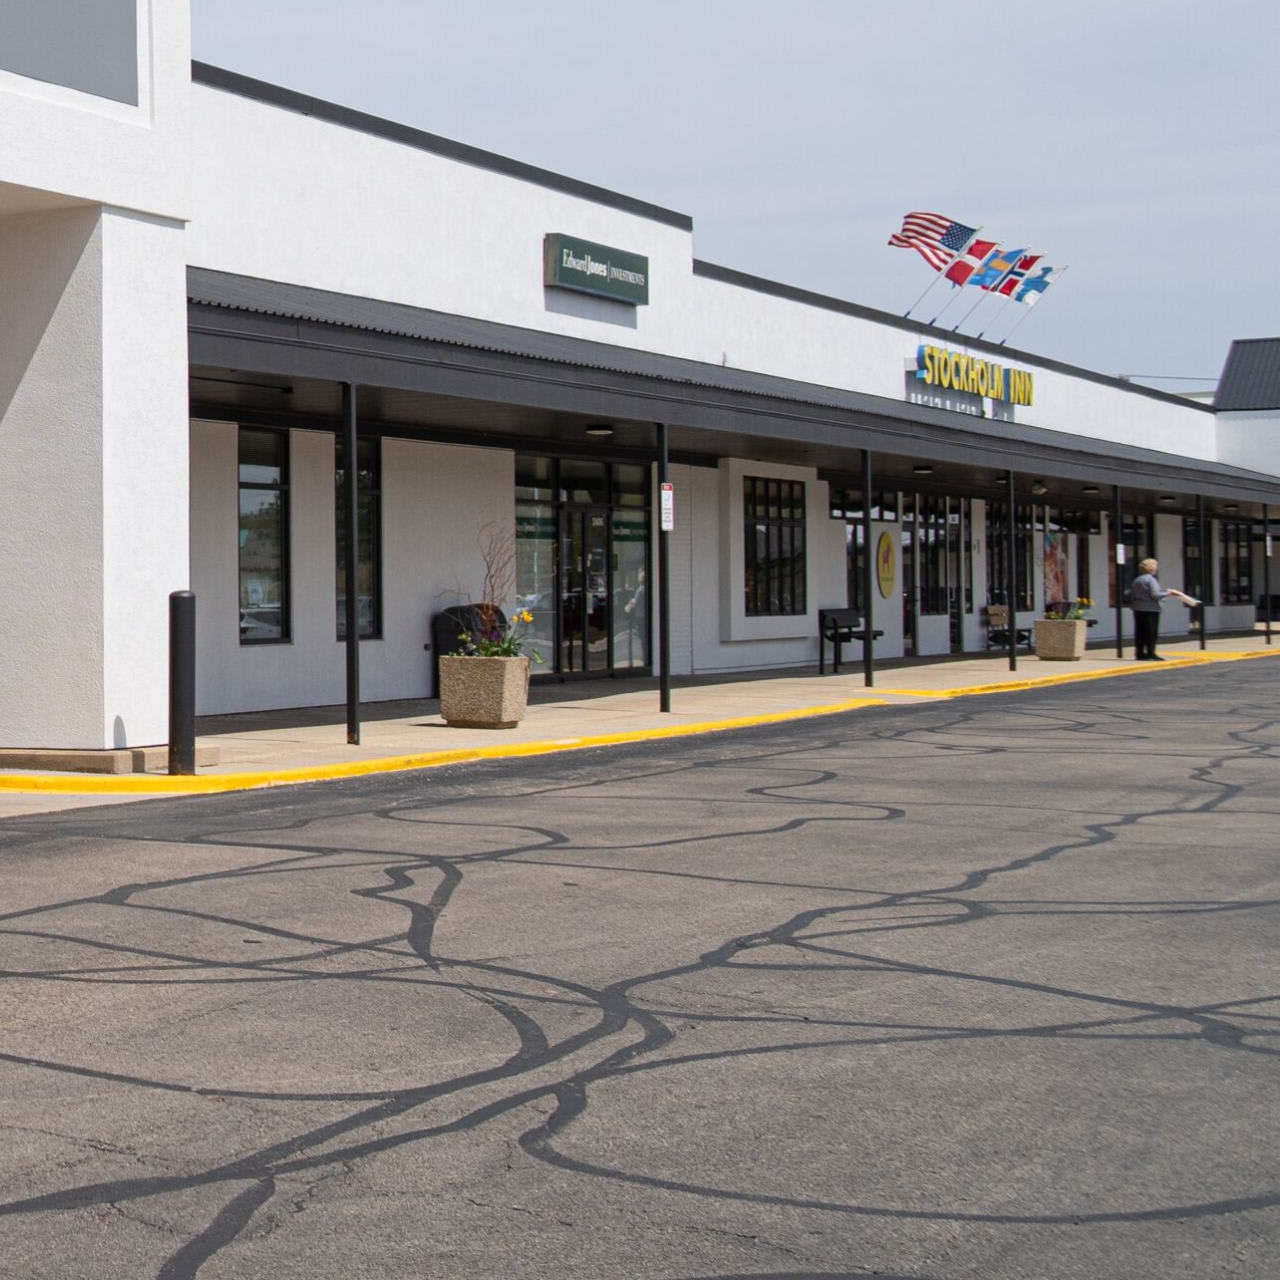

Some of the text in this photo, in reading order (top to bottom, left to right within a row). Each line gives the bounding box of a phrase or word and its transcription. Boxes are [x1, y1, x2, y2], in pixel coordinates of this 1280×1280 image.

[611, 267, 644, 285] INVESTMENTS
[925, 346, 1034, 406] STOCKHOLM INN
